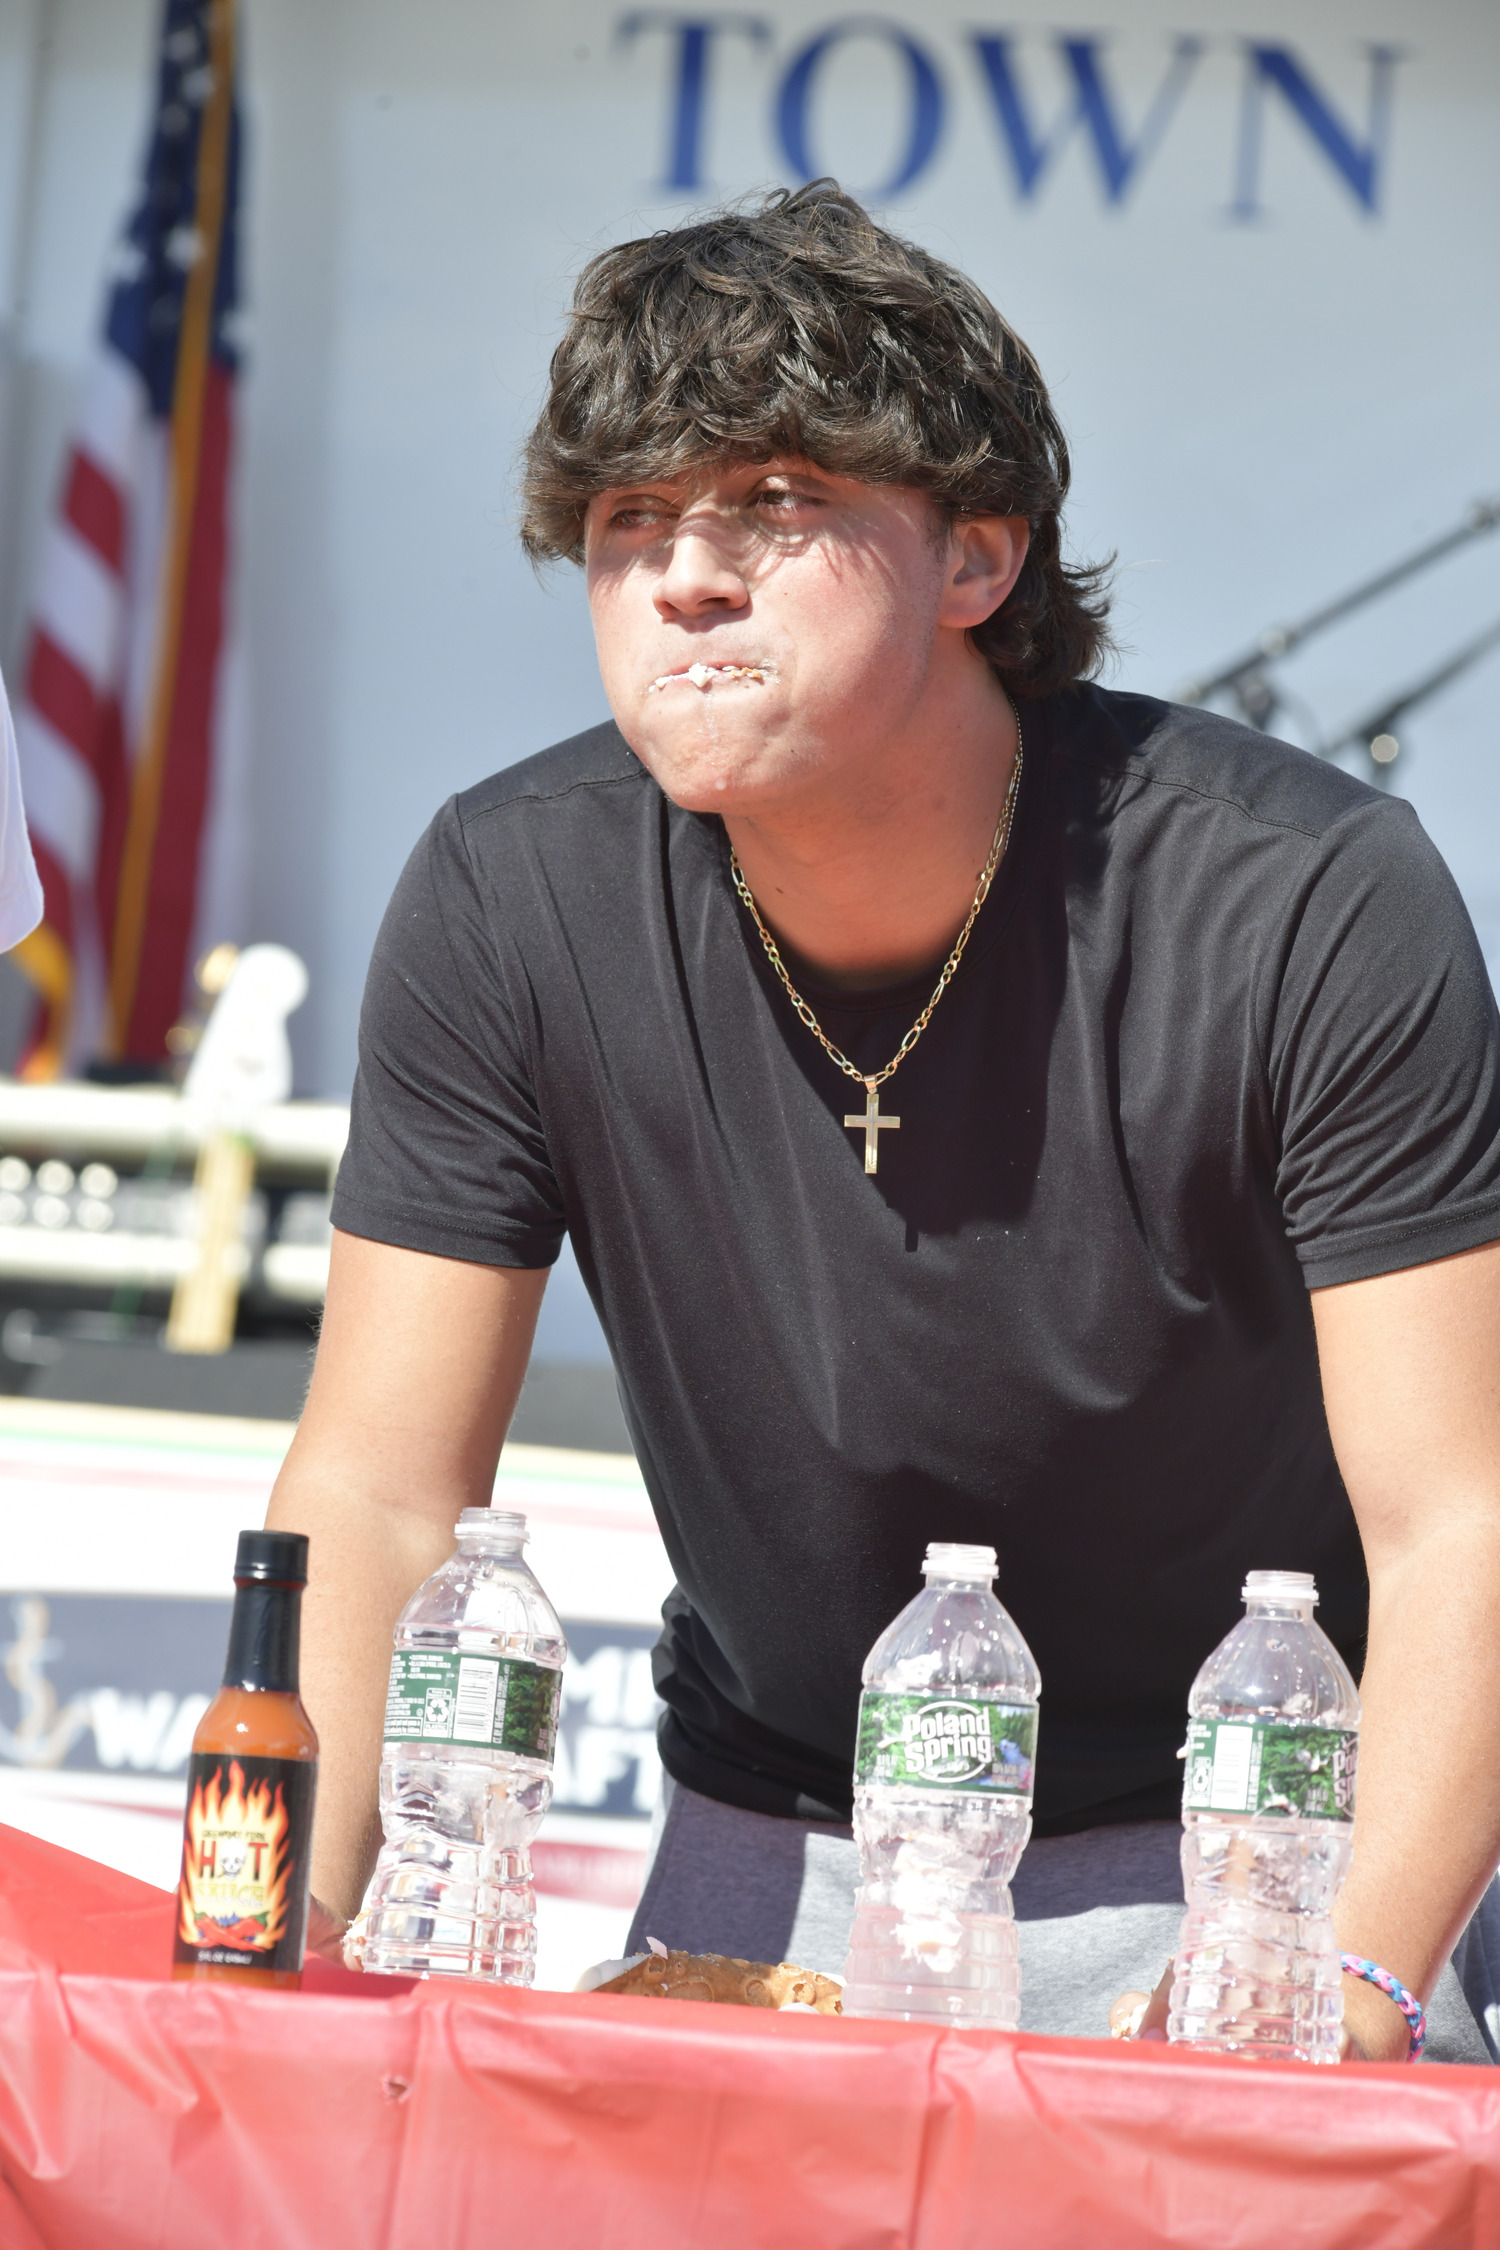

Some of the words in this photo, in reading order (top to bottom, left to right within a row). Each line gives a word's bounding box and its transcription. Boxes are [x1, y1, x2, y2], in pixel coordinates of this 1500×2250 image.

[609, 10, 1416, 225] TOWN
[902, 1706, 992, 1741] Poland
[904, 1734, 993, 1773] Spring
[195, 1882, 265, 1908] SAUCE
